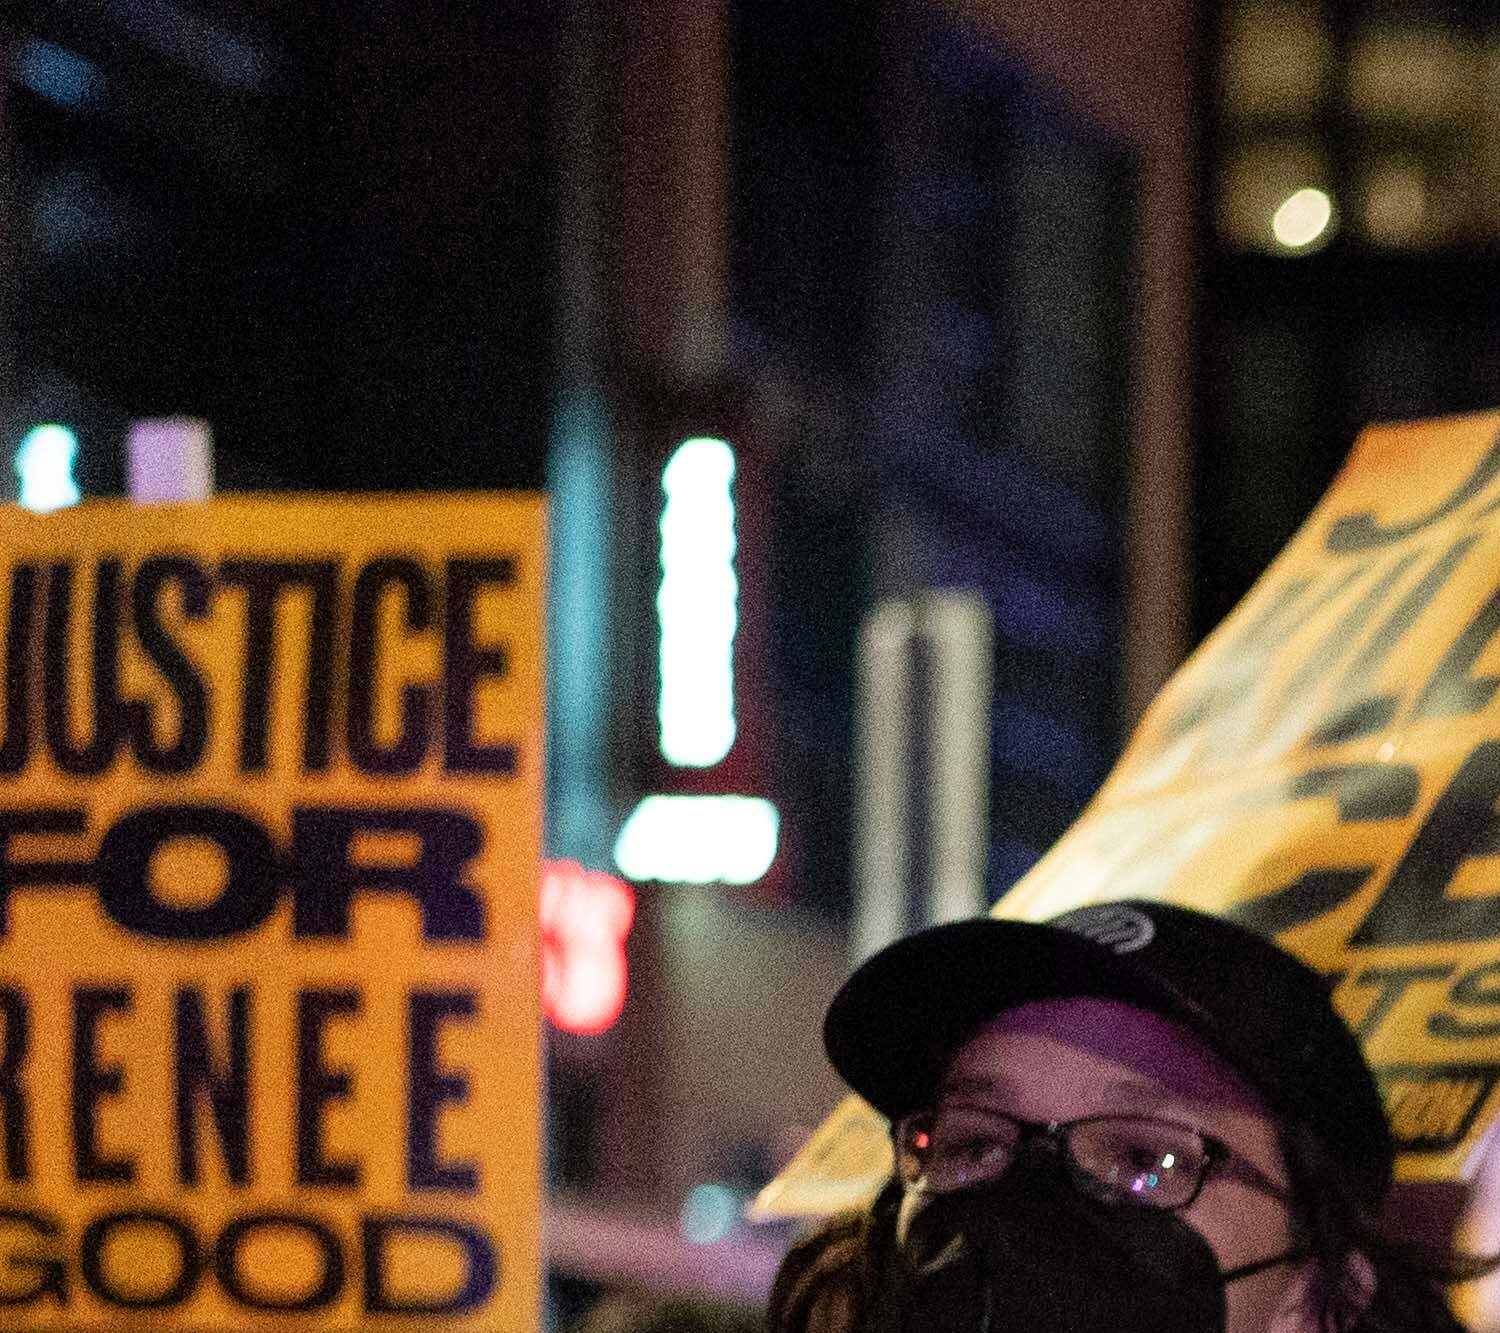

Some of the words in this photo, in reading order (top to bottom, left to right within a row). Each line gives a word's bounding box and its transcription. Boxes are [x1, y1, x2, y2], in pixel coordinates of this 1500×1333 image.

[0, 552, 518, 778] JUSTICE
[0, 804, 488, 944] FOR
[0, 1210, 499, 1316] GOOD
